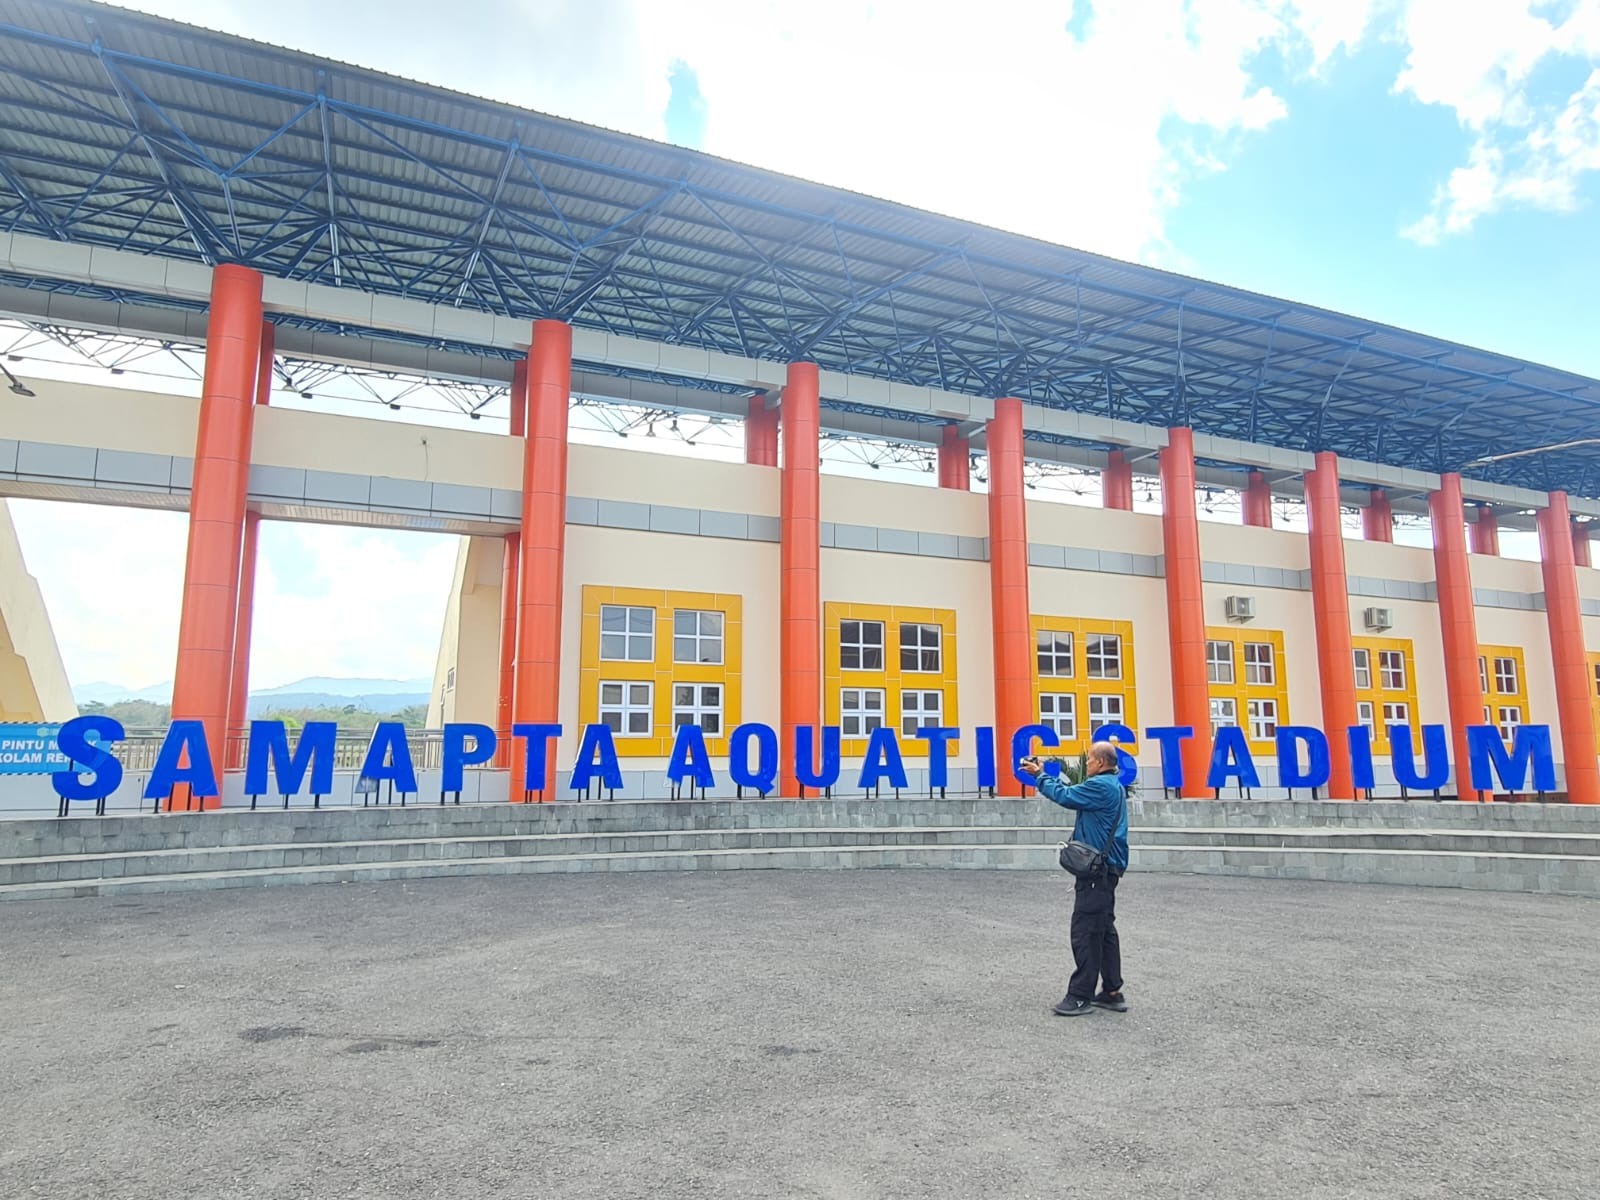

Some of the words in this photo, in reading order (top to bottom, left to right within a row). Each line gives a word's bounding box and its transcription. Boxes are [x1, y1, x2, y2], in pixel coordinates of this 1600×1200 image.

[2, 739, 45, 751] PINTU
[52, 715, 624, 801] SAMAPTA
[665, 722, 1062, 795] AQUATIC
[1092, 723, 1557, 792] STADIUM
